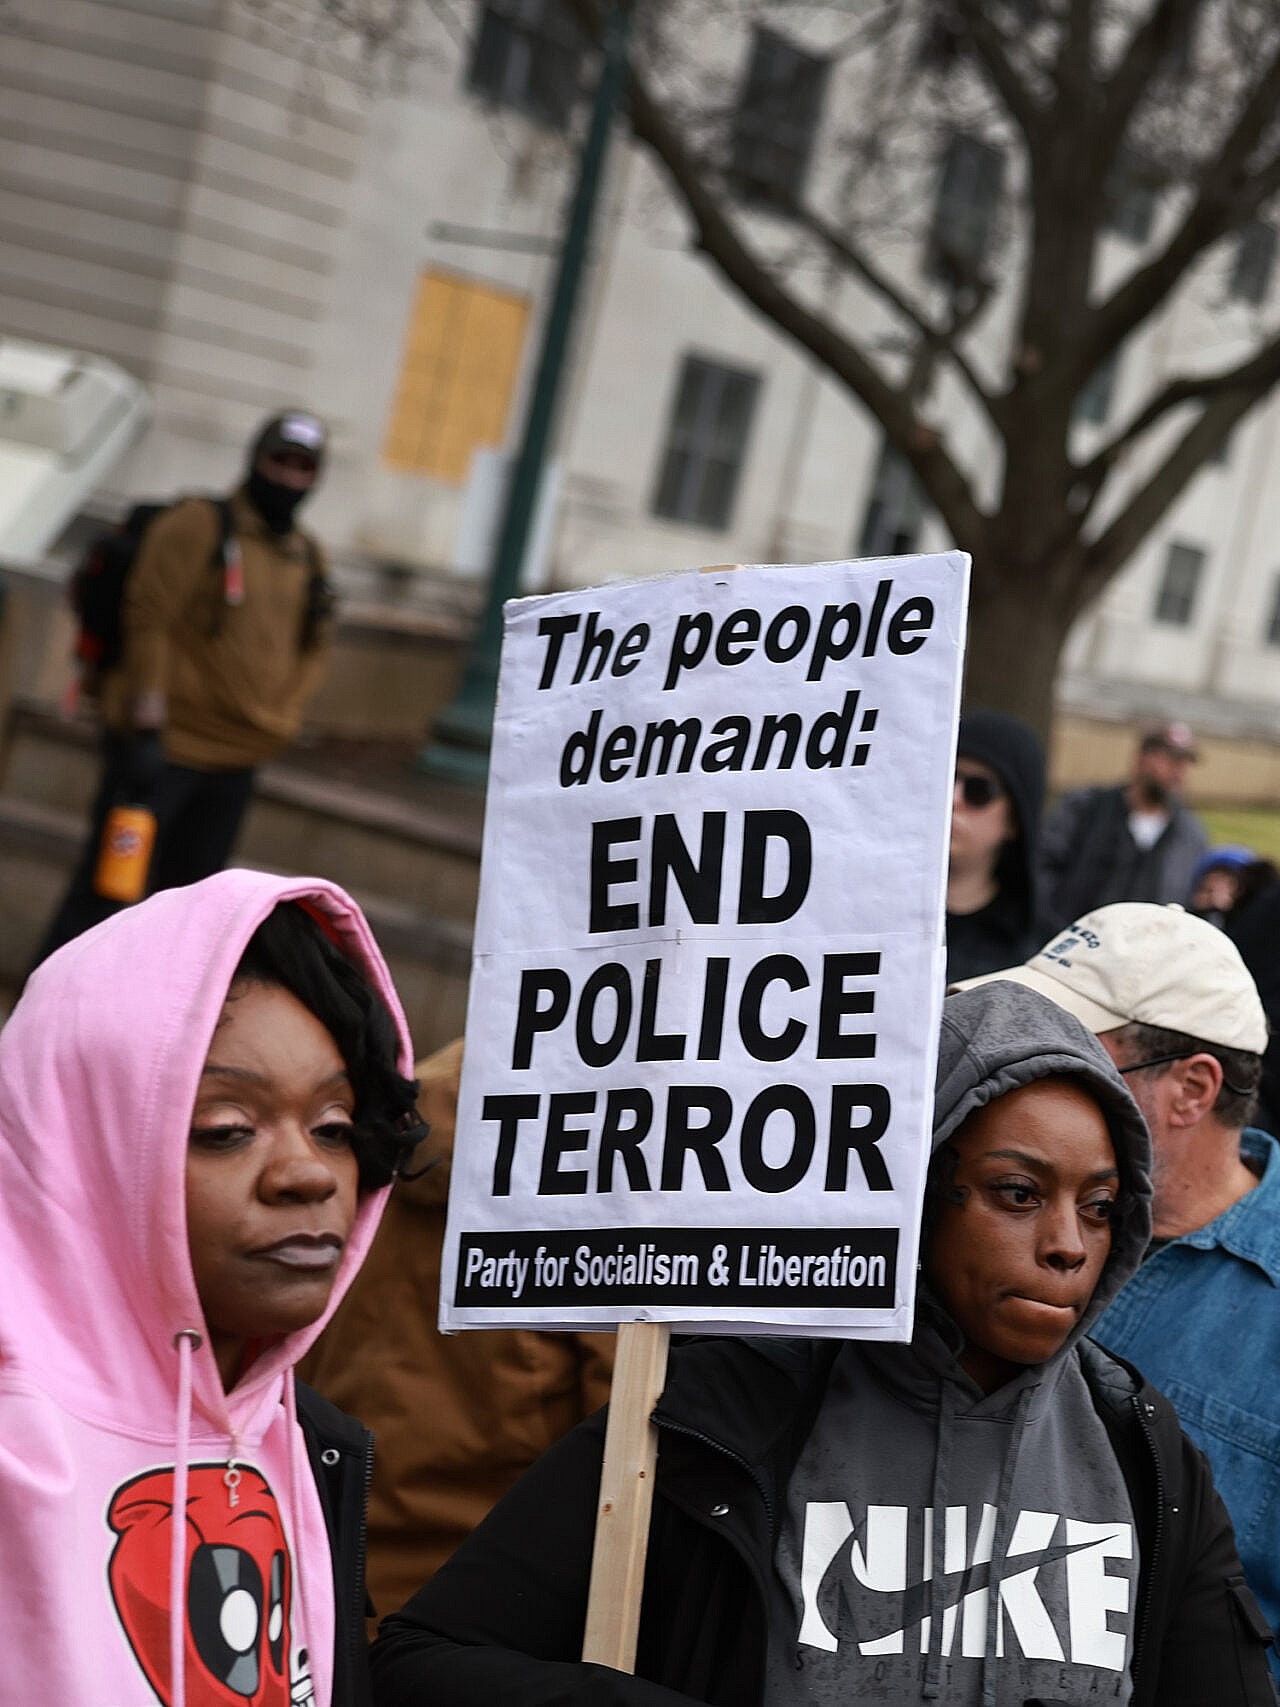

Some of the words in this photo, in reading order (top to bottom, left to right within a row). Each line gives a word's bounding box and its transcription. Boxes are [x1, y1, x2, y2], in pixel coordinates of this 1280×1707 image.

[537, 611, 651, 690] The
[662, 579, 935, 692] people
[559, 689, 879, 788] demand:
[588, 809, 812, 934] END
[511, 952, 882, 1071] POLICE
[481, 1083, 895, 1197] TERROR
[464, 1247, 530, 1298] Party
[534, 1246, 570, 1288] for
[573, 1243, 699, 1287] Socialism
[707, 1244, 730, 1287] &
[738, 1245, 886, 1287] Liberation
[798, 1501, 1133, 1672] NIKE
